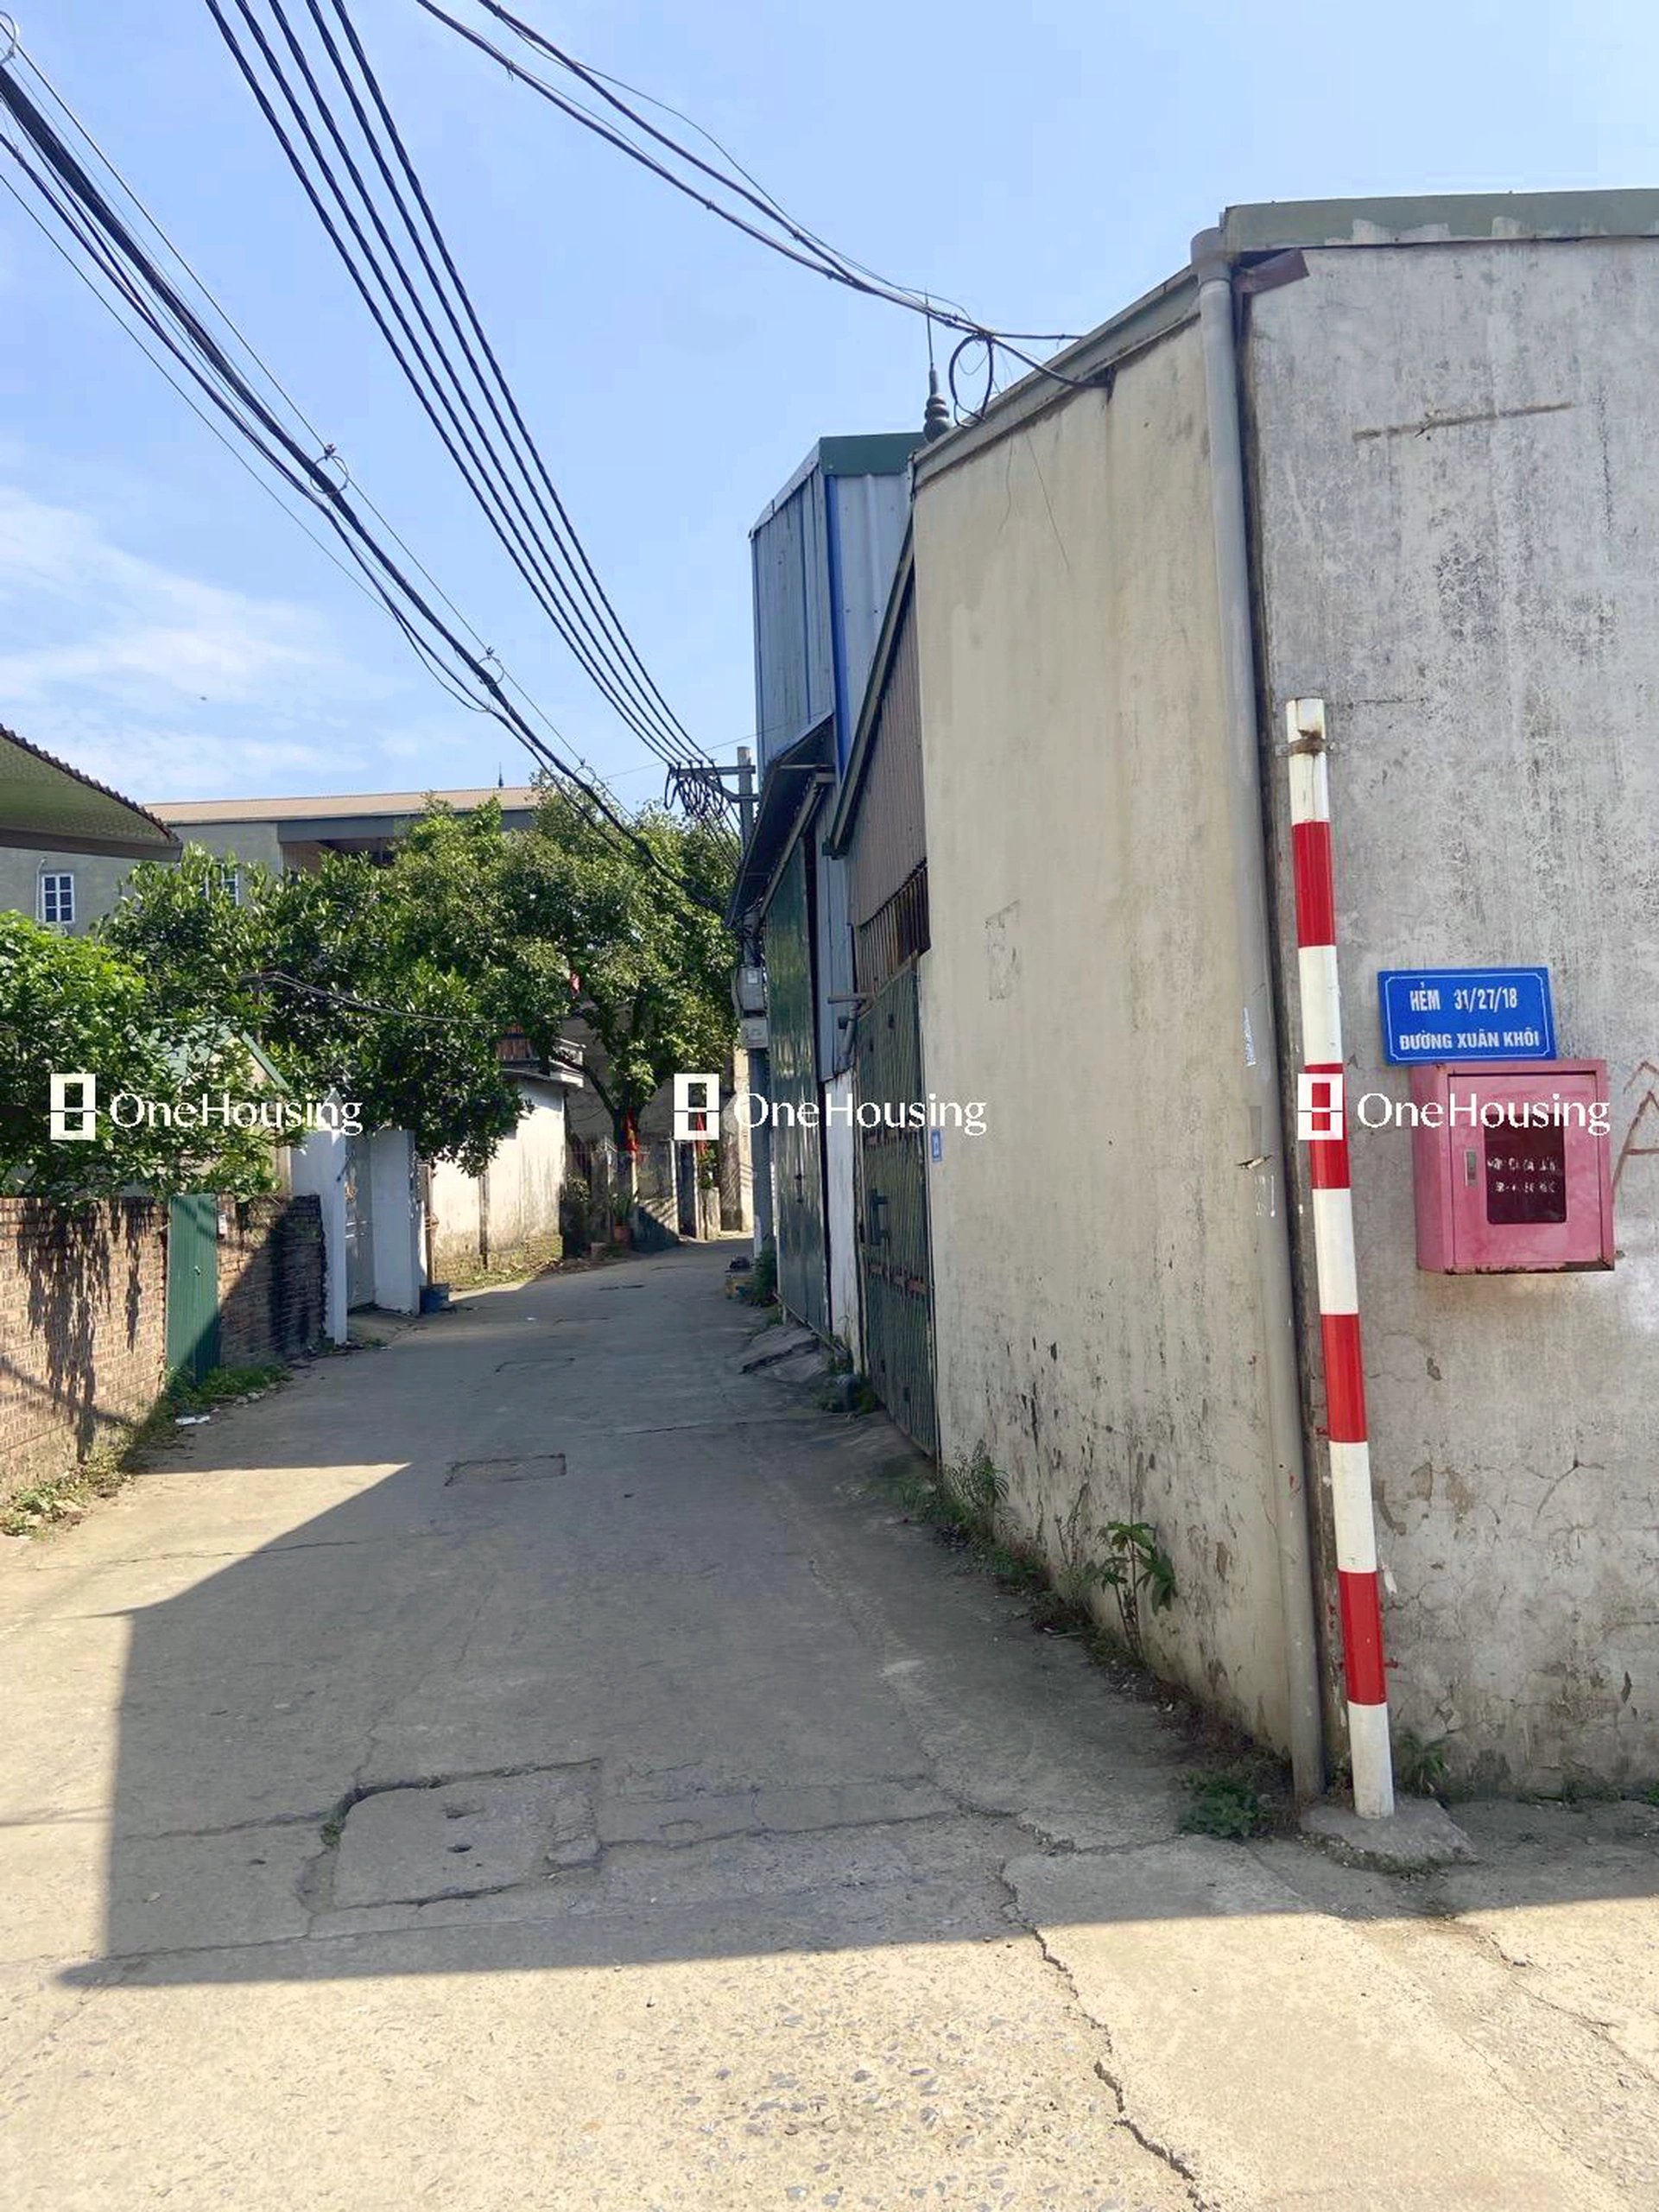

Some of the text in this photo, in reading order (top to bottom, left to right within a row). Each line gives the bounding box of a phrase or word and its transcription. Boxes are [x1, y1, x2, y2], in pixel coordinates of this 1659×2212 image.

[1453, 986, 1518, 1012] 31/27/18
[1399, 1030, 1453, 1050] ĐƯỜNG
[1457, 1029, 1500, 1048] XUÂN
